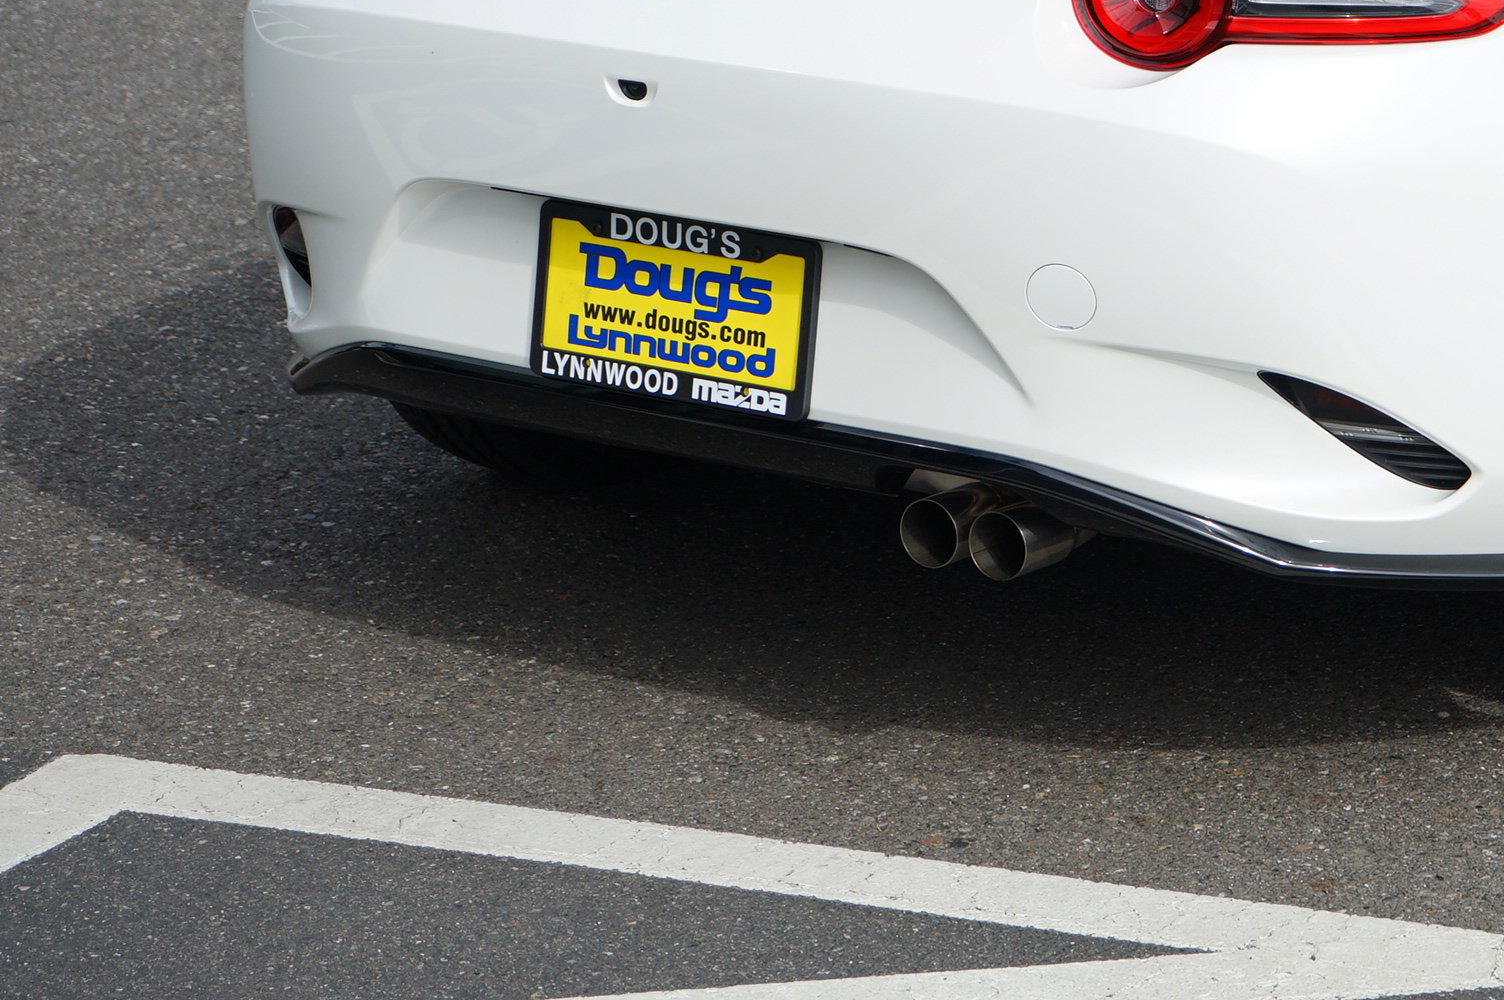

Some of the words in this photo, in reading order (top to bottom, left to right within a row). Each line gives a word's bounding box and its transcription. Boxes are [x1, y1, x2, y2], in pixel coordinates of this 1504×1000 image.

[609, 212, 742, 260] DOUG'S
[567, 314, 776, 378] Lynnwood
[583, 302, 766, 349] www.dougs.com
[541, 350, 679, 397] LYNNWOOD
